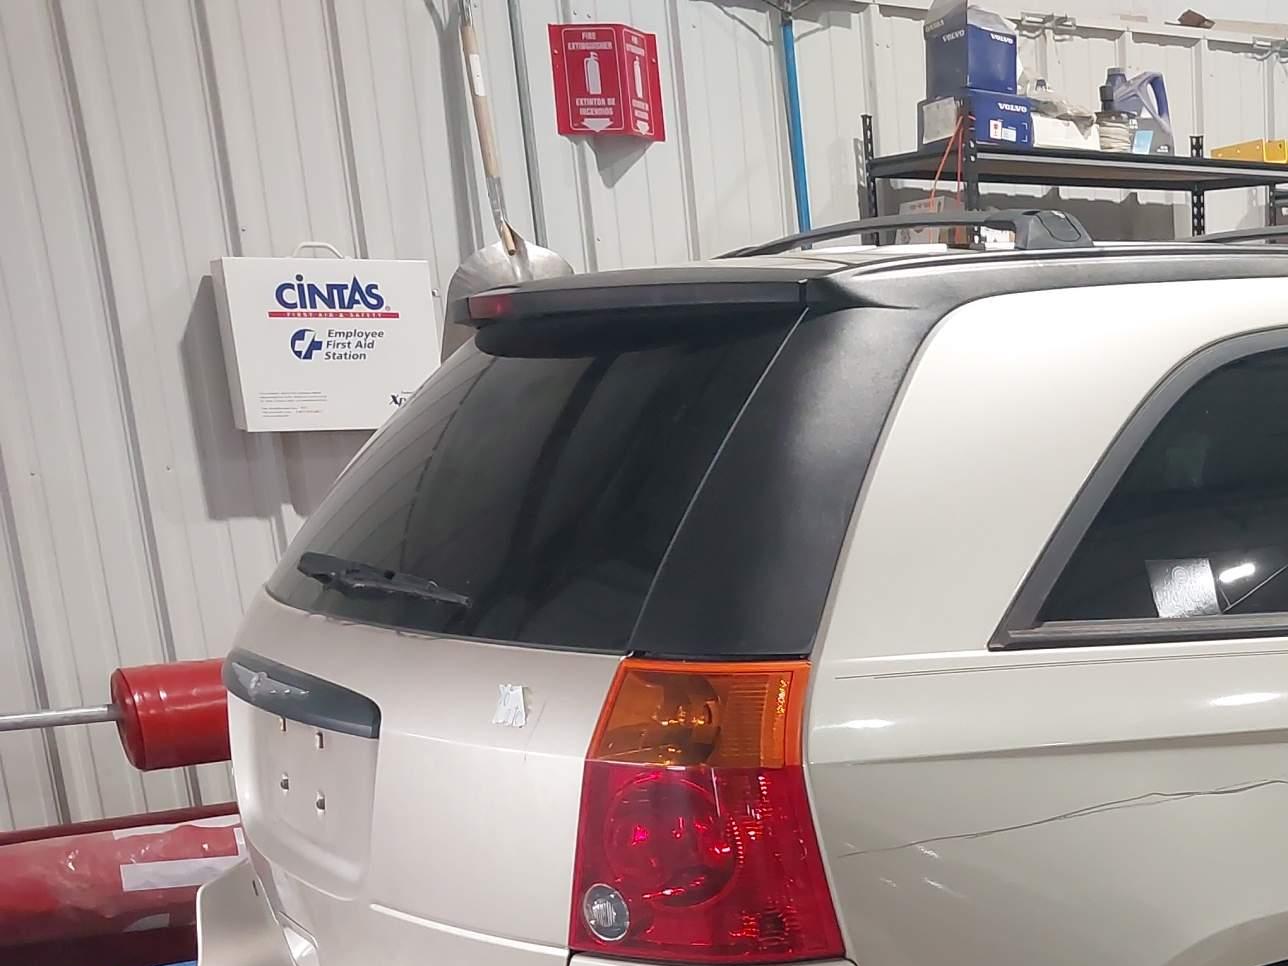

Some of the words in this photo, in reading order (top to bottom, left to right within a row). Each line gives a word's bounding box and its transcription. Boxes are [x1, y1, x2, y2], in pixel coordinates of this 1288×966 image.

[990, 32, 1014, 44] VOLVO
[997, 102, 1028, 113] VOLVO
[327, 329, 384, 341] Employee
[325, 340, 352, 349] First
[354, 340, 375, 349] Aid
[324, 351, 367, 360] Station
